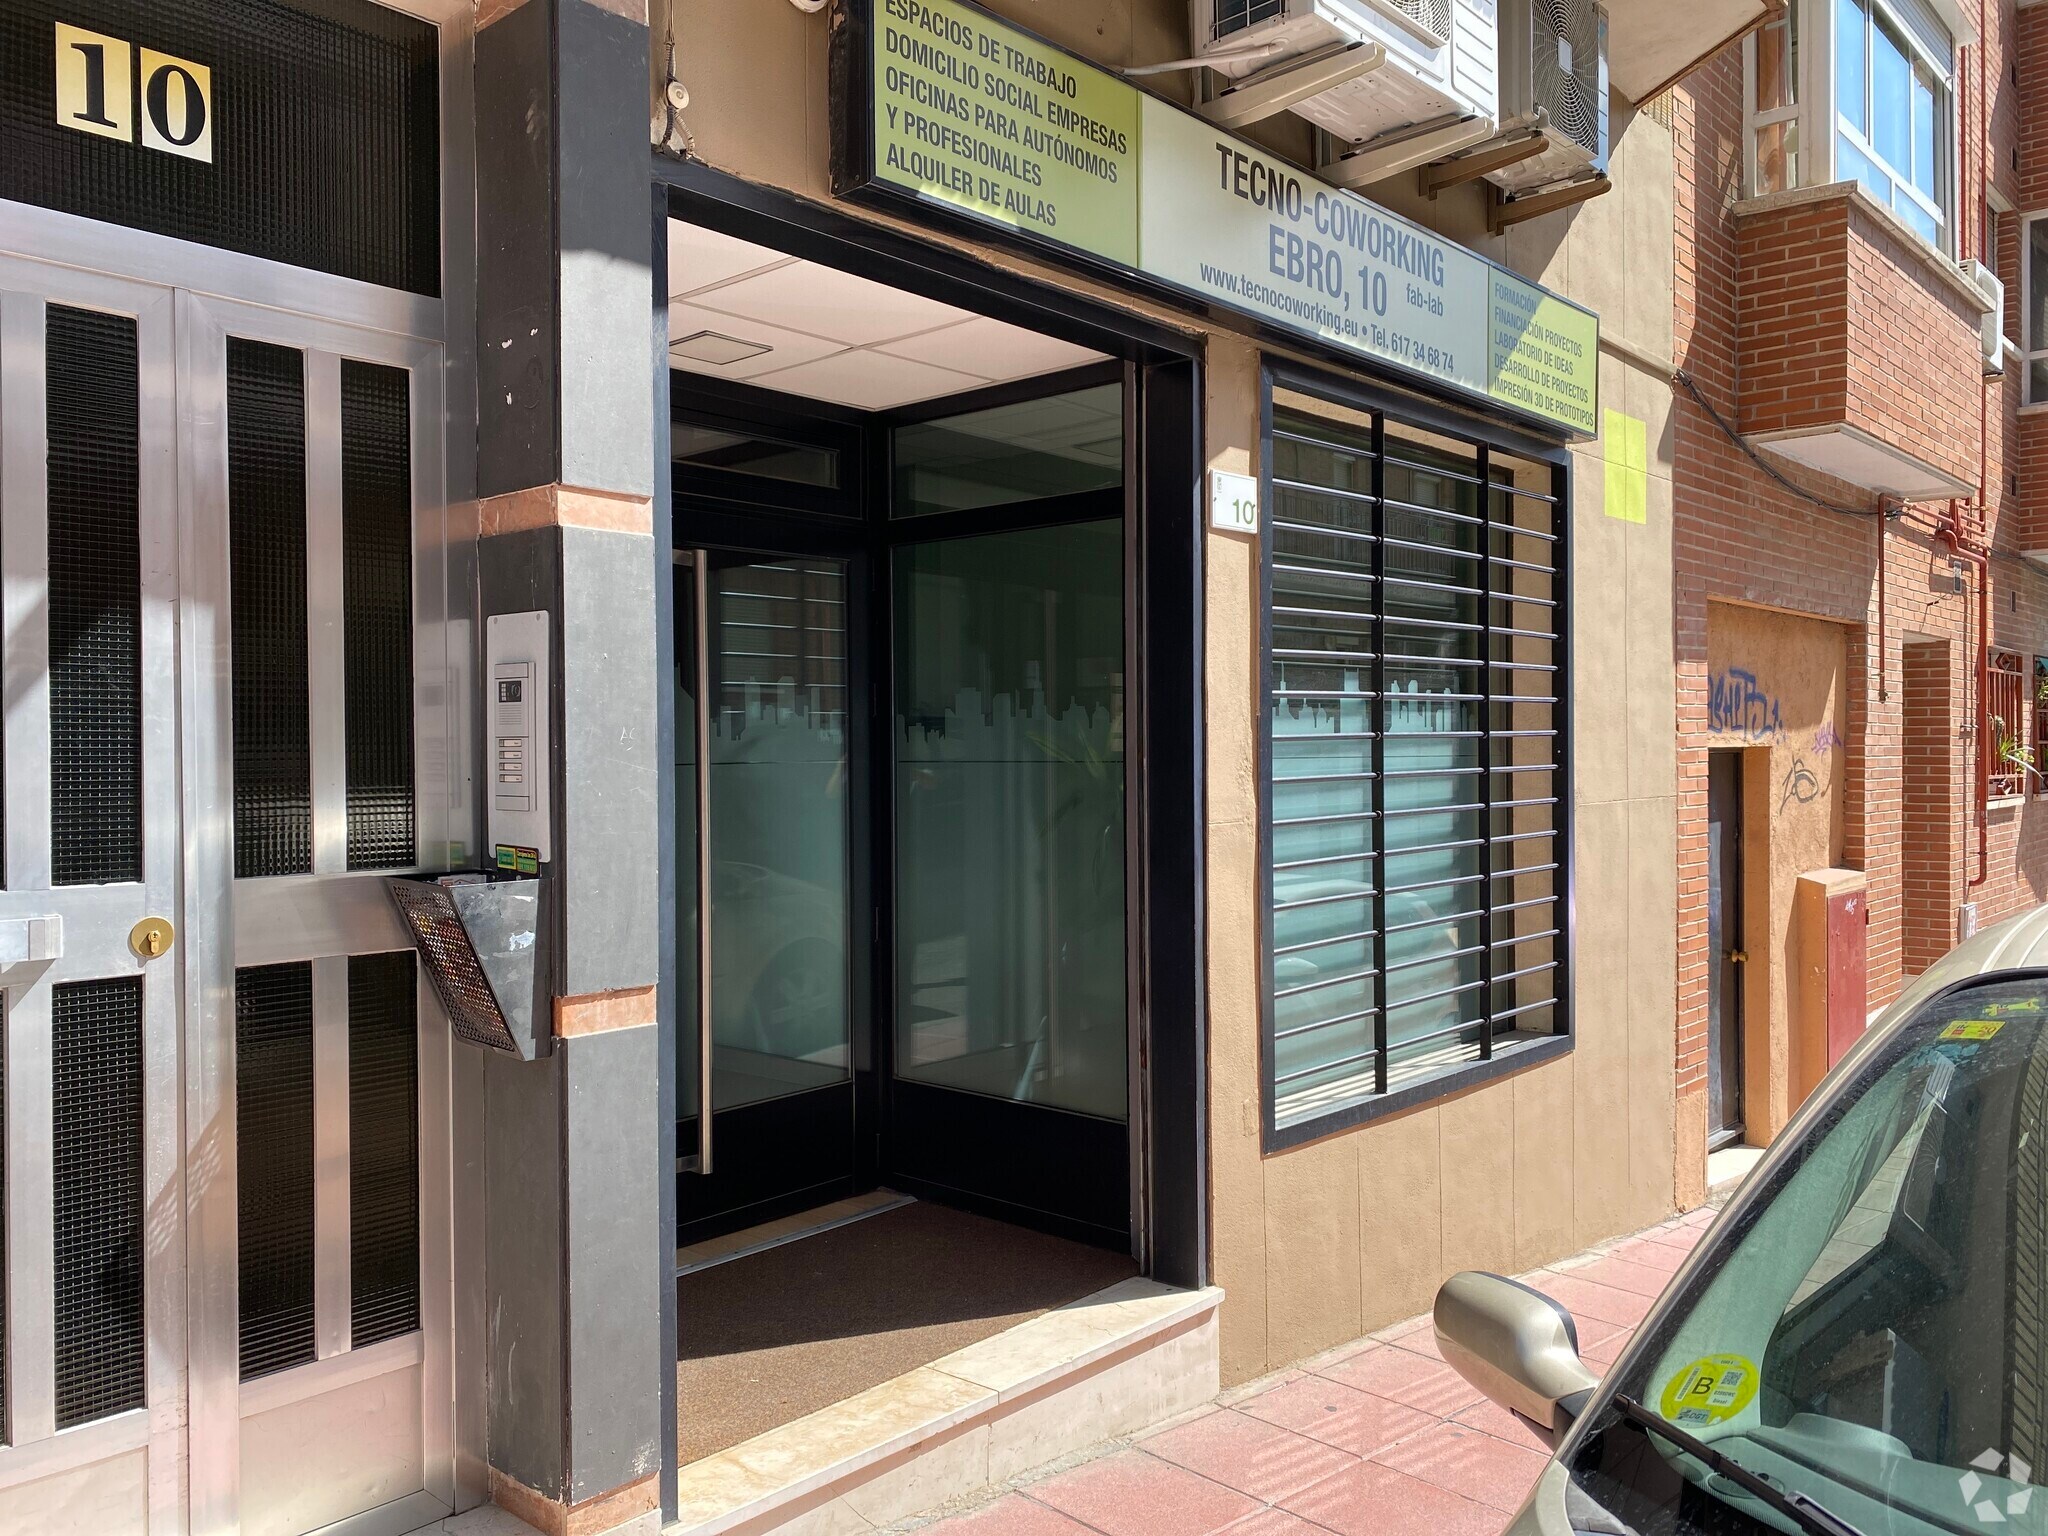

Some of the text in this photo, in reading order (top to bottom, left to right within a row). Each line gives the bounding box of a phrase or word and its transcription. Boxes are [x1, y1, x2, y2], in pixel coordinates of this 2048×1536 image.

[886, 0, 1077, 99] ESPACIOS DE TRABAJO
[886, 27, 1127, 154] DOMICILIO SOCIAL EMPRESAS
[71, 42, 206, 146] 10
[885, 66, 1118, 184] OFICINAS PARA AUTÓNOMOS
[885, 103, 1042, 186] Y PROFESIONALES
[886, 143, 1056, 227] ALQUILER DE AULAS
[1215, 142, 1444, 288] TECNO-COWORKING
[1269, 223, 1388, 317] EBRO, 10
[1406, 282, 1444, 317] fab-lab
[1495, 282, 1537, 315] FORMACIÓN
[1200, 262, 1454, 373] www.tecnocoworking.eu Tel. 617 34 68 74
[1495, 306, 1583, 358] FINANCIACIÓN PROYECTOS
[1495, 329, 1573, 376] LABORATORIO DE IDEAS
[1495, 352, 1588, 404] DESARROLLO DE PROYECTOS
[1495, 376, 1594, 426] IMPRESIÓN 3D DE PROTOTIPOS
[1232, 498, 1254, 525] 10
[1692, 1376, 1714, 1394] B
